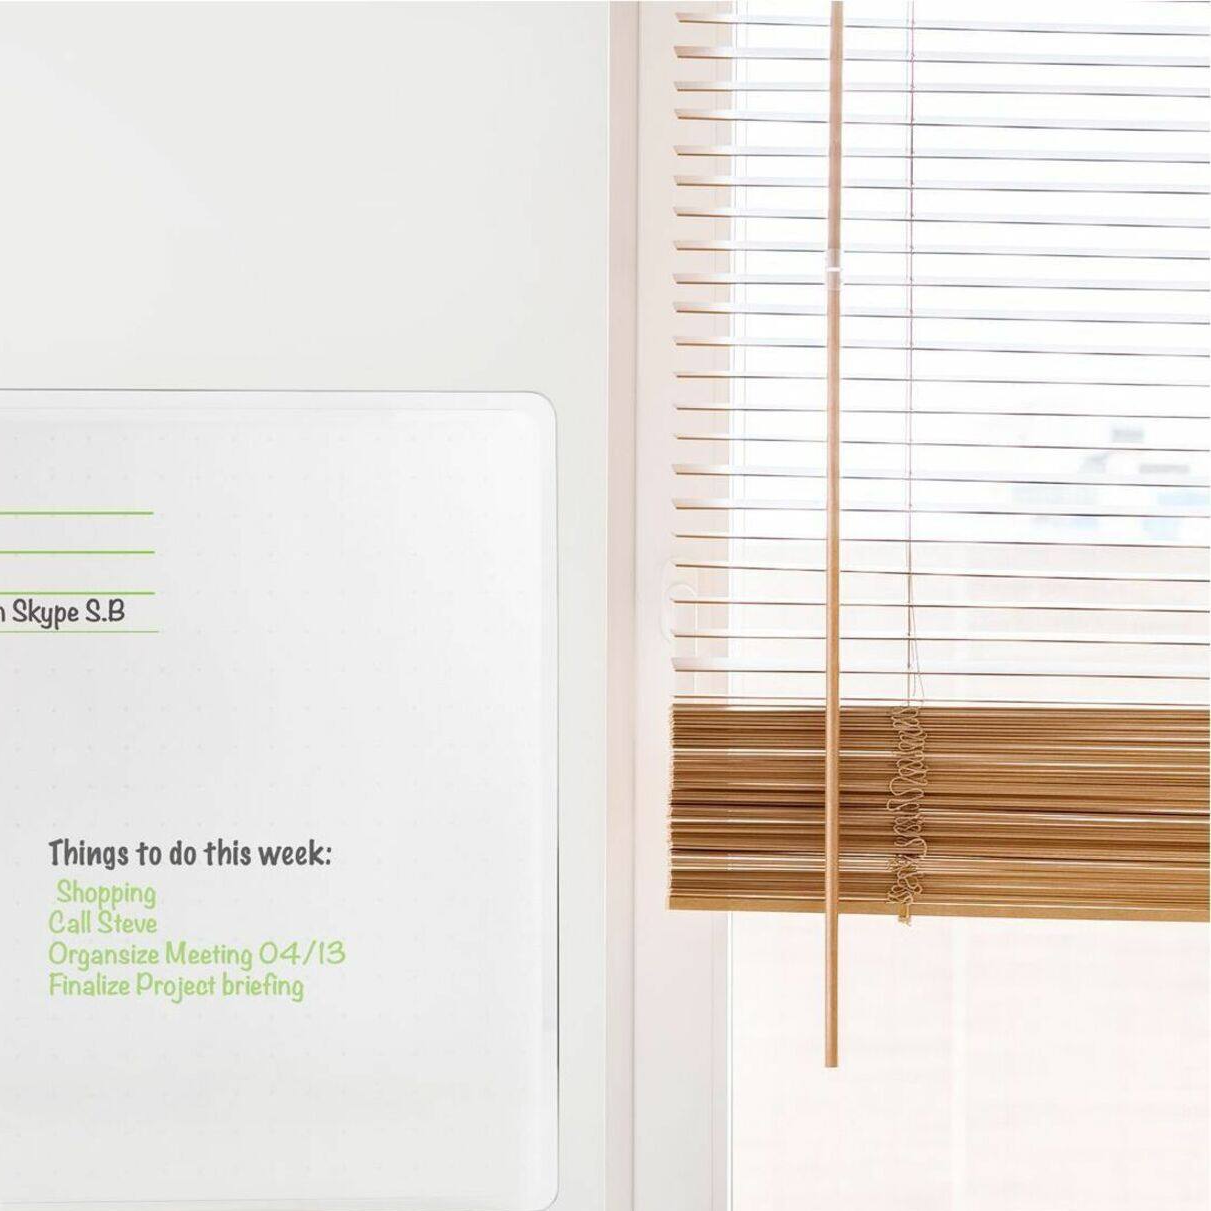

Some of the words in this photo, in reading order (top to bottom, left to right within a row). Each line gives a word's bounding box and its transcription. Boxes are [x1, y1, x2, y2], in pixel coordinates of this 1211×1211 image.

[12, 600, 79, 629] Skype
[85, 600, 125, 622] S.B
[48, 839, 128, 870] Things
[136, 842, 161, 866] to
[170, 841, 197, 866] do
[204, 839, 251, 866] this
[259, 839, 332, 866] week:
[57, 879, 156, 909] Shopping
[49, 910, 90, 933] Call
[98, 910, 157, 933] Steve
[49, 942, 159, 971] Organsize
[166, 942, 252, 971] Meeting
[260, 941, 346, 965] 04/13
[50, 974, 130, 996] Finalize
[137, 973, 215, 1003] Project
[223, 973, 304, 1002] briefing
